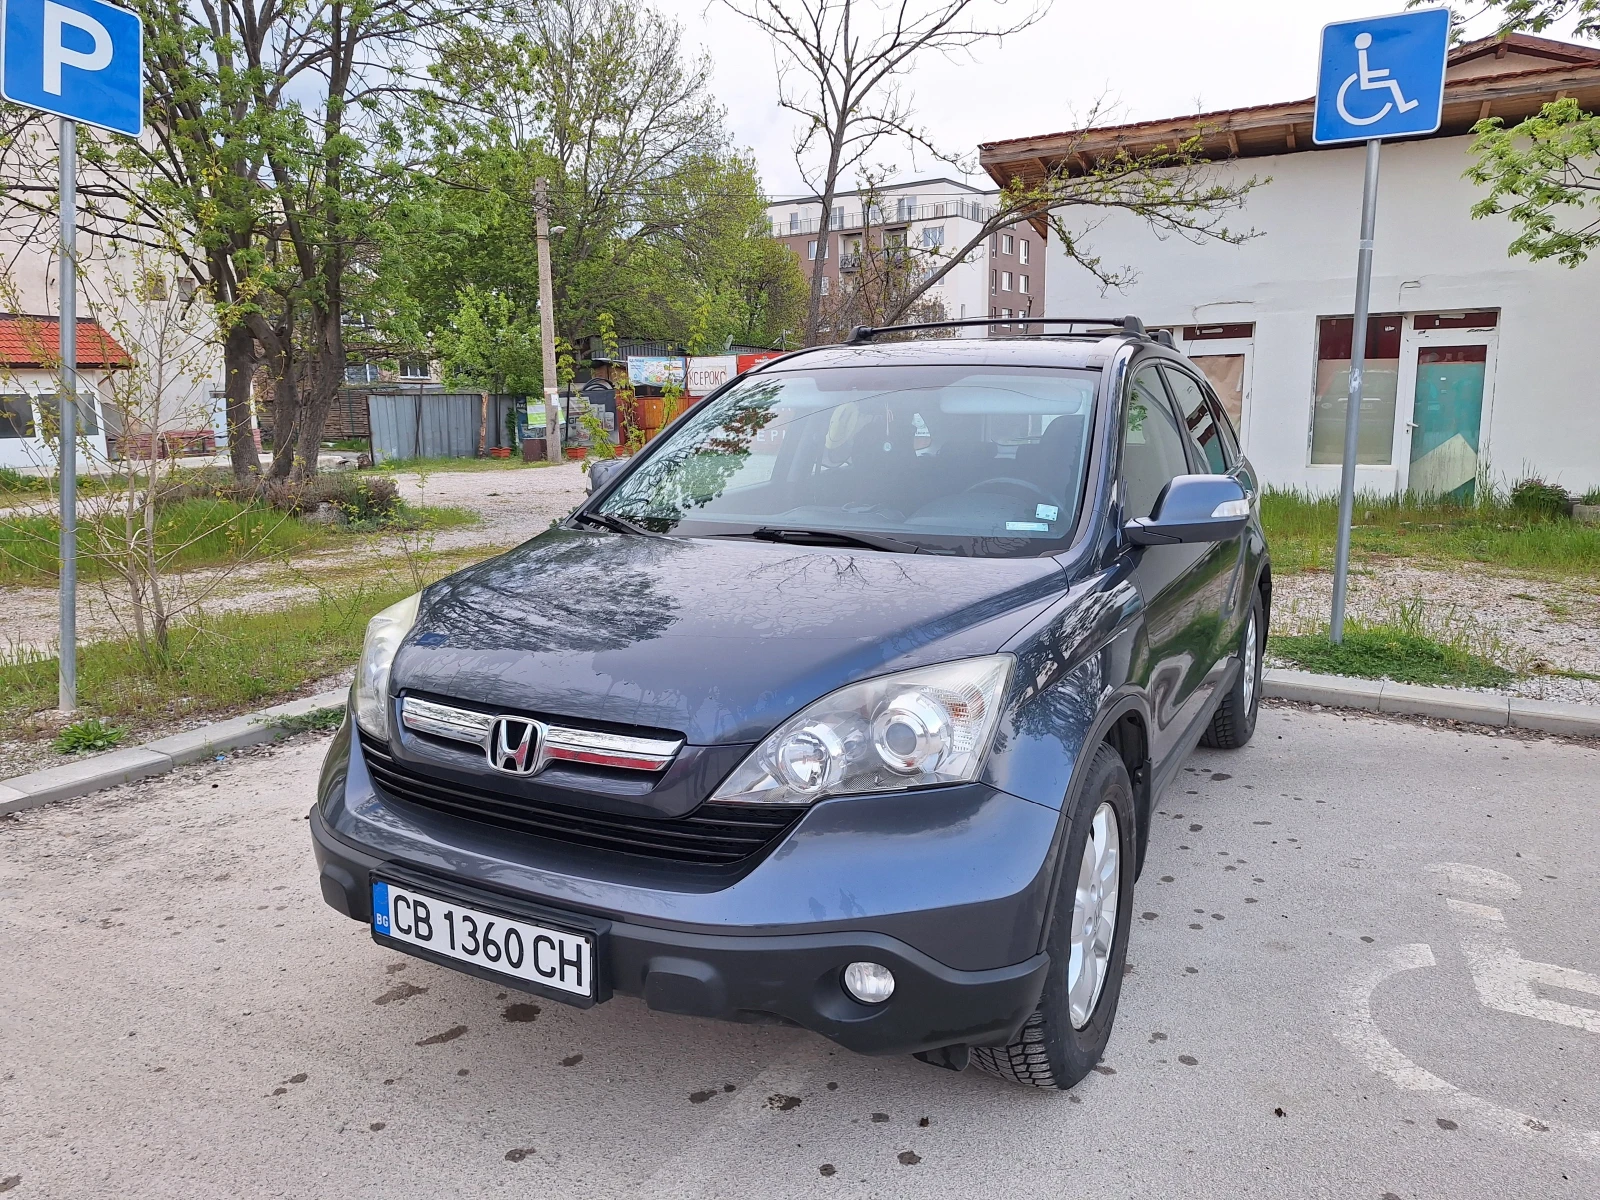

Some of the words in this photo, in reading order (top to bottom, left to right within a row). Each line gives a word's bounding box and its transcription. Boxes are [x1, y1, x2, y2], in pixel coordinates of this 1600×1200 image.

[43, 0, 113, 96] P
[688, 369, 726, 386] КСЕРОКС
[376, 912, 389, 928] BG
[393, 894, 433, 942] CB
[444, 910, 524, 969] 1360
[533, 935, 583, 987] CH
